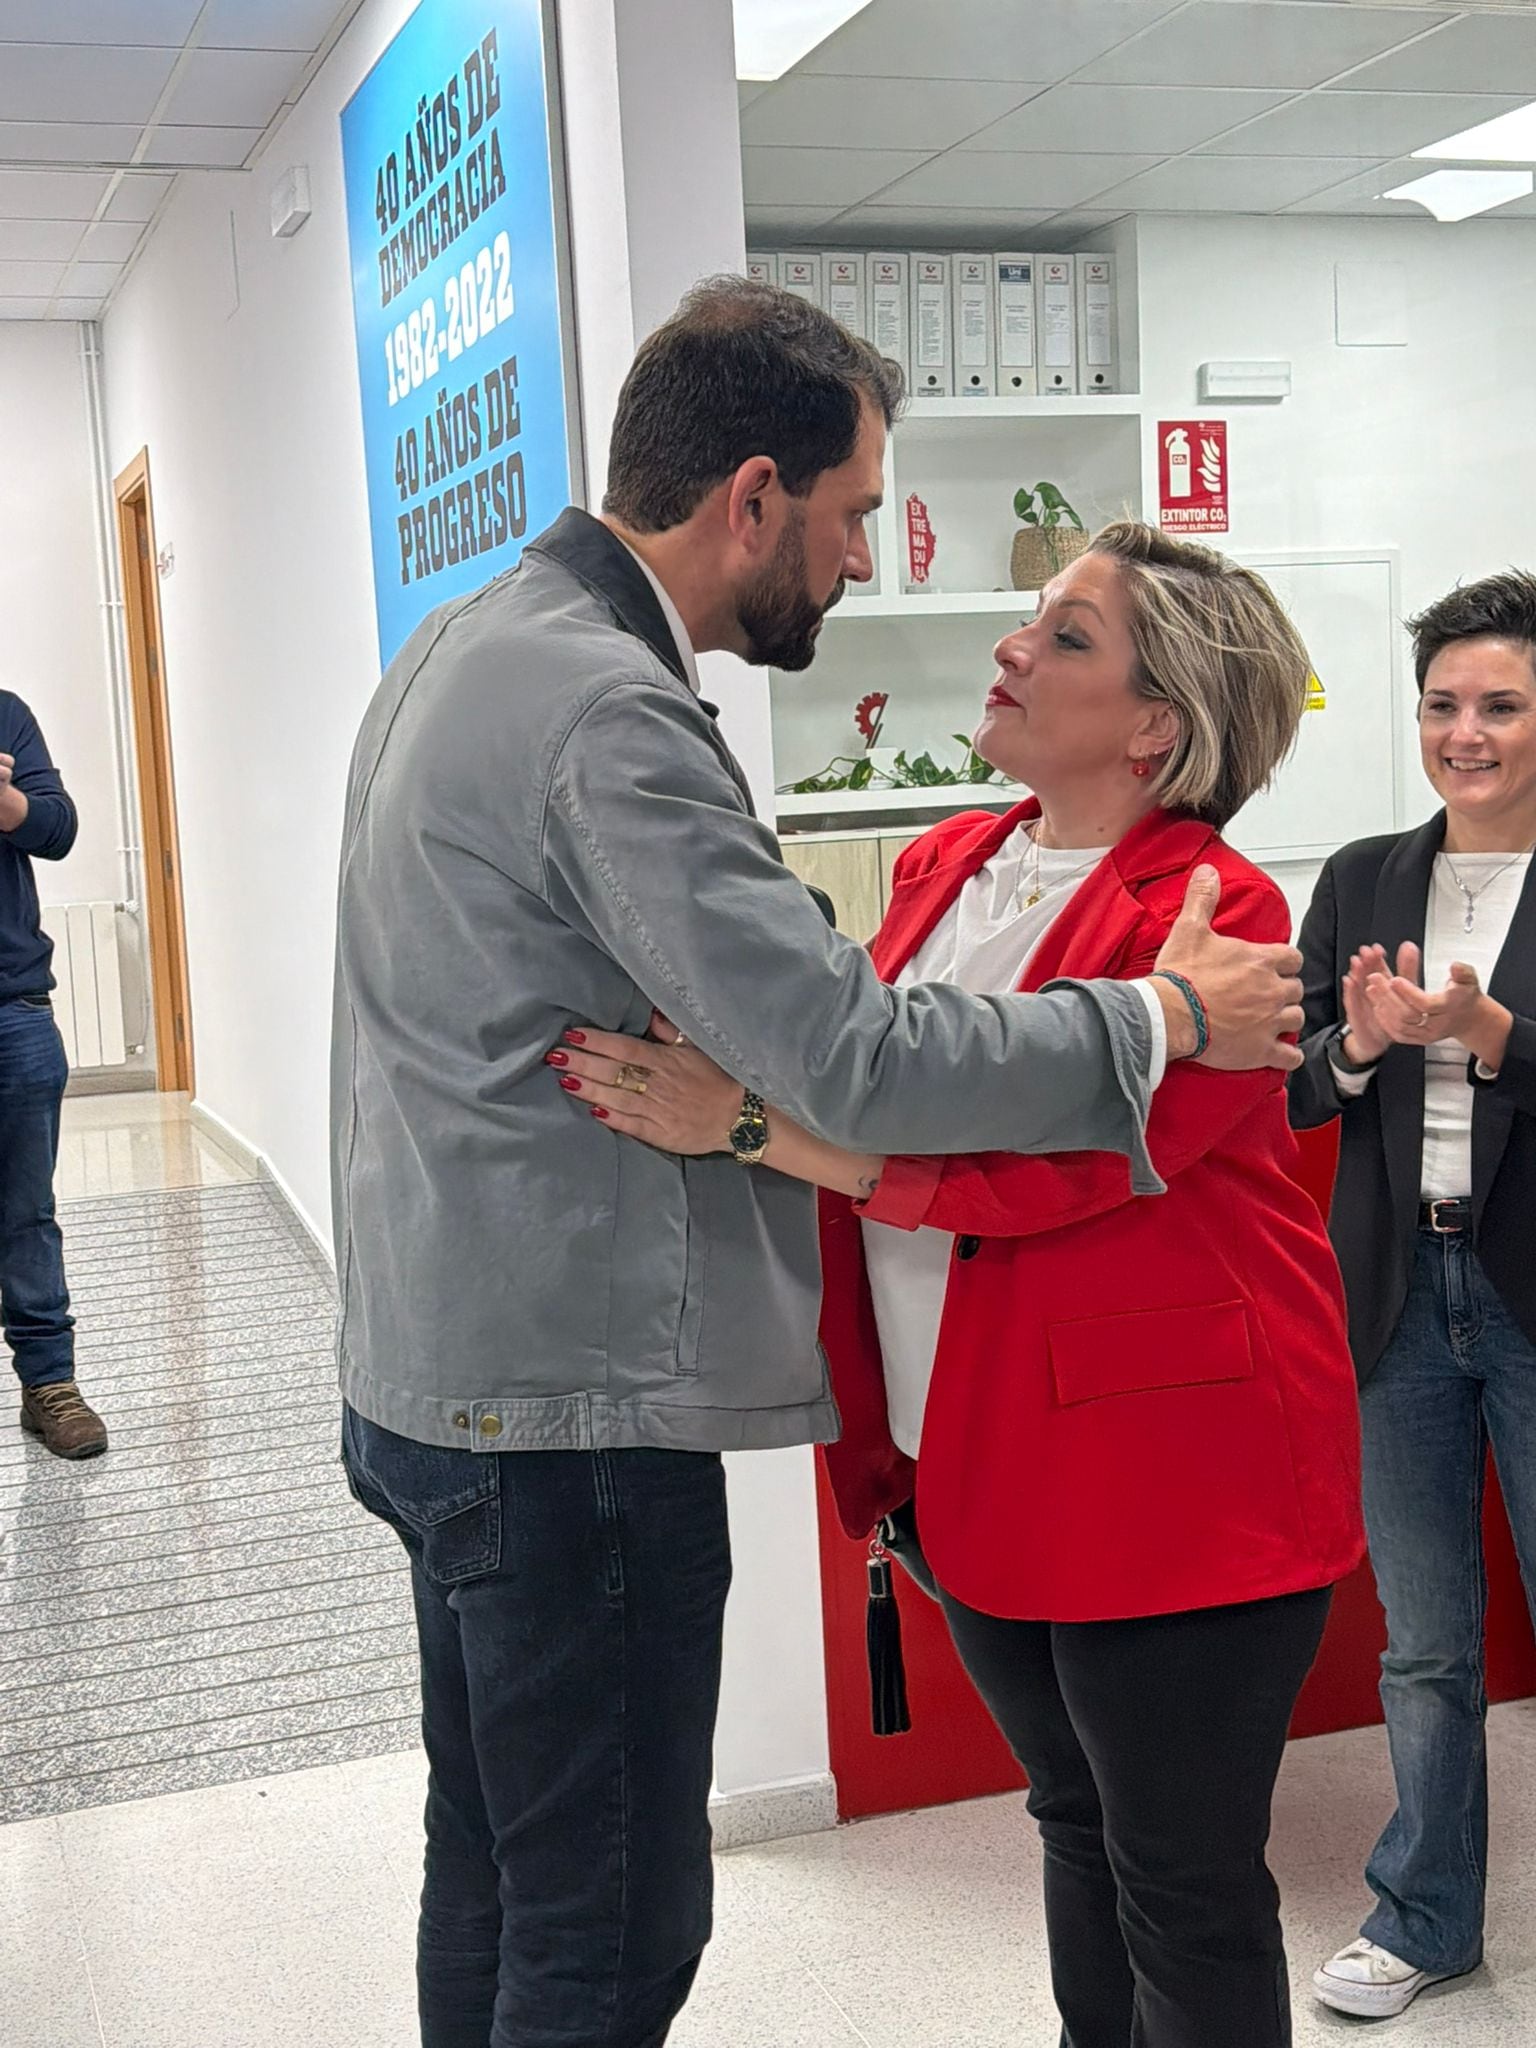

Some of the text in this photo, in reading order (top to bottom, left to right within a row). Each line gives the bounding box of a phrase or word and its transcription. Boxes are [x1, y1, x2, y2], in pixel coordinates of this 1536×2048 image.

[375, 26, 501, 236] 40 AÑOS DE
[378, 126, 506, 308] DEMOCRACIA
[384, 229, 516, 408] 1982-2022
[394, 354, 522, 502] 40 AÑOS DE
[911, 502, 922, 517] EX
[1161, 508, 1208, 522] EXTINTOR
[397, 450, 527, 586] PROGRESO
[911, 517, 927, 533] TRE
[1188, 522, 1227, 530] ELÉCTRICO
[912, 533, 927, 549] MA
[913, 549, 926, 564] DU
